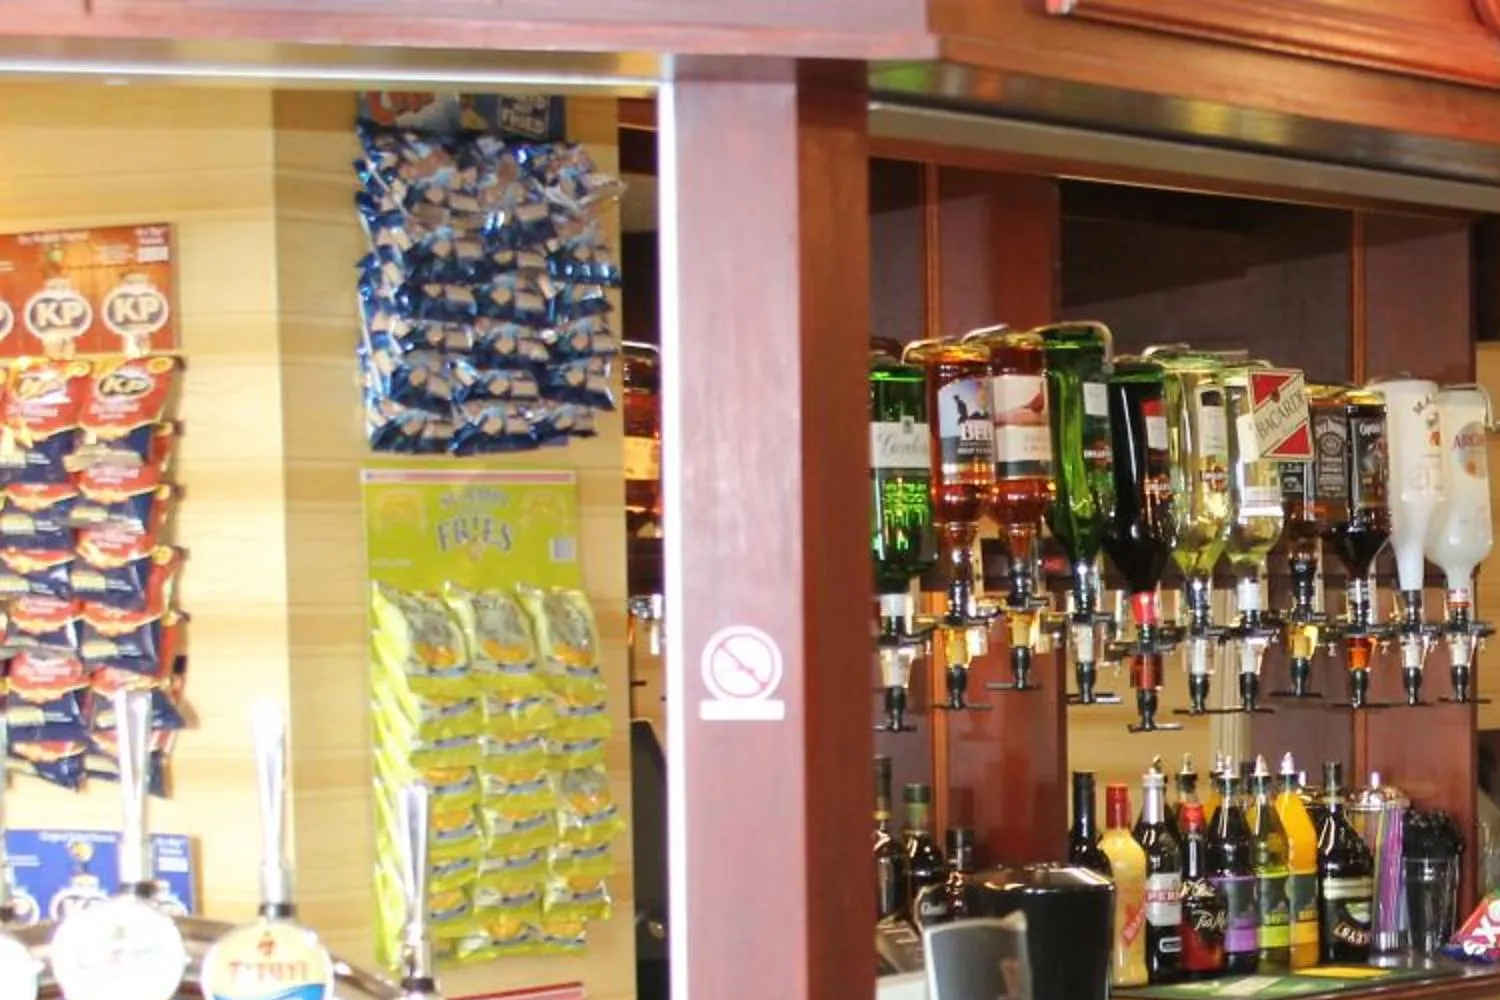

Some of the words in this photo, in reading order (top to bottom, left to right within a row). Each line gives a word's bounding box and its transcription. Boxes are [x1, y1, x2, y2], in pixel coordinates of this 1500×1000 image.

[35, 300, 85, 328] KP
[113, 296, 161, 324] KP
[1256, 389, 1307, 441] BACARDI
